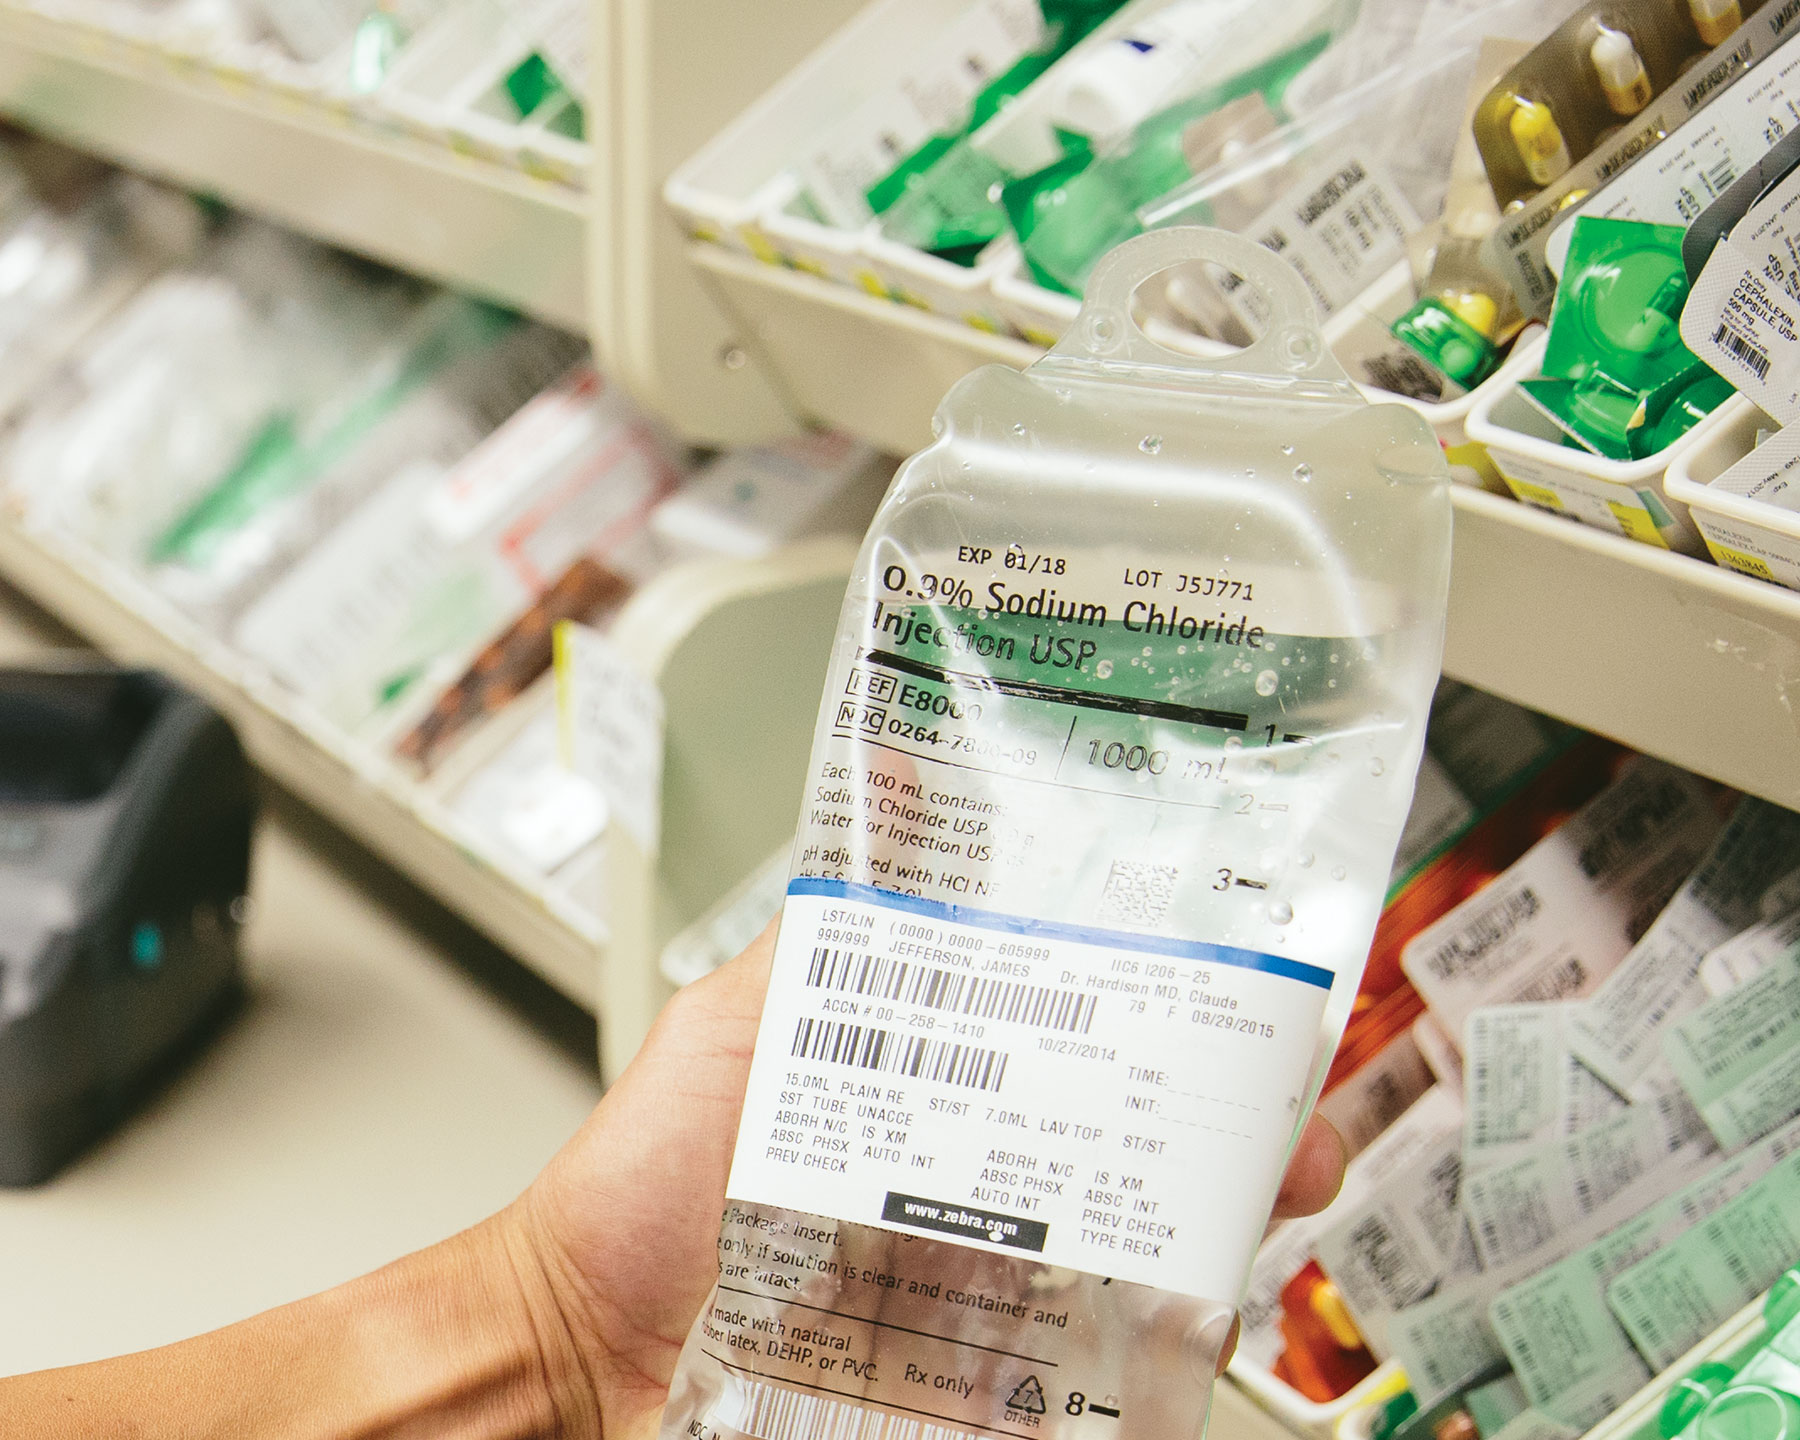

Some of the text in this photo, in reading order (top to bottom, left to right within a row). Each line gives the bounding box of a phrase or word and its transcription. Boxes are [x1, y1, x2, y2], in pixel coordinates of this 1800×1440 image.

[1767, 254, 1784, 281] USP
[1728, 297, 1755, 326] 500 mg
[1733, 288, 1775, 330] CAPSULE,
[1778, 322, 1798, 344] USP
[1739, 278, 1796, 328] CEPHALEXIN
[958, 545, 1066, 576] EXP 01/18
[1720, 550, 1768, 575] 1363845
[1124, 568, 1254, 601] LOT J5J771
[882, 564, 1266, 649] 0.9% Sodium Chloride
[871, 601, 1098, 671] Injection USP
[898, 684, 983, 722] E8000
[1265, 723, 1277, 748] 1
[1087, 738, 1230, 785] 1000 mL
[821, 762, 855, 781] Each
[865, 770, 897, 791] 100
[899, 780, 925, 801] mL
[878, 797, 948, 830] Chloride
[953, 817, 988, 837] USP
[1234, 793, 1255, 815] 2
[809, 808, 854, 828] Water
[887, 822, 961, 857] Injection
[801, 846, 817, 867] pH
[820, 849, 891, 875] adjuted
[896, 862, 933, 885] with
[939, 874, 969, 894] HCl
[1212, 867, 1233, 892] 3
[817, 929, 1031, 977] 999/999 JEFFERSON, JAMES
[821, 909, 1050, 961] LST/LIN 0000 0000 605999
[1060, 971, 1238, 1010] Dr. Hardison MD, Claude
[1192, 970, 1211, 985] 25
[822, 998, 985, 1039] ACCN 00 258 1410
[1128, 1000, 1275, 1038] 79 F 08/29/2015
[1037, 1037, 1117, 1061] 10/27/2014
[1128, 1066, 1170, 1087] TIME:
[779, 1091, 915, 1127] SST TUBE UNACCE
[784, 1072, 1167, 1155] 15.0ML PLAIN RE ST/ST 7.0ML LAV TOP ST/ST
[1124, 1095, 1161, 1115] INIT:
[774, 1110, 908, 1146] ABORH N/C IS XM
[765, 1146, 849, 1174] PREV CHECK
[770, 1128, 936, 1170] ABSC PHSX AUTO INT
[986, 1149, 1143, 1192] ABORH N/C IS XM
[979, 1168, 1160, 1215] ABSC PHSX ABSC INT
[729, 1208, 790, 1238] Package
[792, 1220, 843, 1247] Insert.
[904, 1201, 1019, 1237] www.zebra.com
[970, 1186, 1177, 1241] AUTO INT PREV CHECK
[1080, 1229, 1163, 1259] TYPE RECK
[725, 1263, 750, 1279] are
[754, 1270, 802, 1293] intact.
[726, 1238, 755, 1261] only
[757, 1243, 769, 1261] if
[771, 1247, 839, 1277] solution
[843, 1263, 857, 1279] is
[860, 1267, 904, 1291] clear
[909, 1278, 941, 1301] and
[945, 1288, 1029, 1320] container
[1033, 1308, 1068, 1329] and
[714, 1307, 852, 1353] made with natural
[726, 1329, 761, 1356] latex,
[766, 1340, 814, 1368] DEHP,
[818, 1355, 838, 1373] or
[841, 1357, 880, 1383] PVC.
[903, 1364, 927, 1385] Rx
[933, 1374, 975, 1399] only
[1024, 1390, 1035, 1405] 7
[1064, 1391, 1085, 1416] 8
[1003, 1409, 1041, 1429] OTHER
